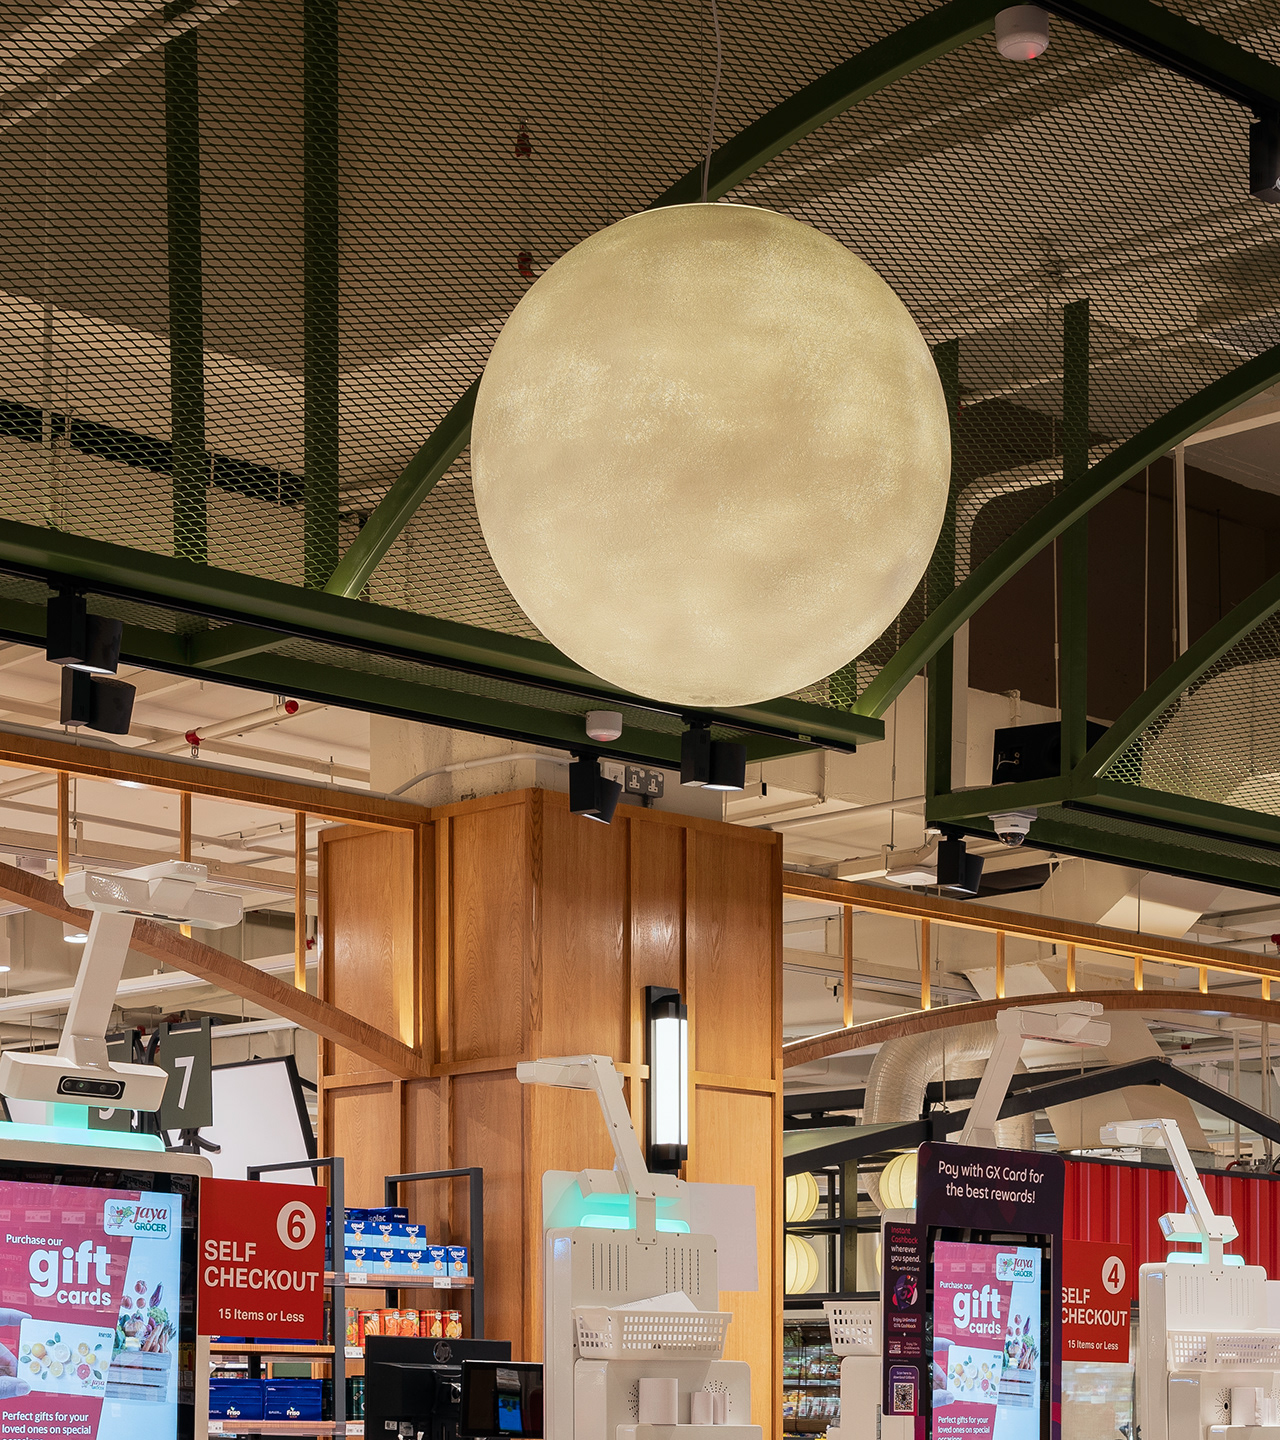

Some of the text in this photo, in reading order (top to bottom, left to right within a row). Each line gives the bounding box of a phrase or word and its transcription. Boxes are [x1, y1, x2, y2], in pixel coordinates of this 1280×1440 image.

[175, 1056, 194, 1109] 7
[939, 1161, 1044, 1183] Pay with GX Card for
[946, 1183, 1035, 1203] the best rewards!
[130, 1206, 167, 1223] Jaya
[134, 1222, 167, 1232] GROCER
[288, 1209, 305, 1243] 6
[6, 1234, 62, 1246] Purchase our
[891, 1235, 918, 1244] Cashback
[204, 1240, 256, 1262] SELF
[891, 1245, 916, 1253] wherever
[891, 1255, 921, 1263] you spend.
[29, 1240, 111, 1298] gift
[1108, 1263, 1119, 1288] 4
[204, 1267, 319, 1292] CHECKOUT
[940, 1281, 962, 1289] Purchase
[57, 1288, 111, 1306] cards
[1062, 1287, 1090, 1304] SELF
[219, 1308, 304, 1323] 15 Items or Less
[953, 1285, 1001, 1329] gift
[969, 1321, 1001, 1334] cards
[1068, 1340, 1076, 1348] 15
[1077, 1340, 1093, 1349] Items
[1104, 1341, 1118, 1350] Less
[2, 1411, 88, 1423] Perfect gifts for your
[2, 1425, 25, 1434] loved
[27, 1426, 48, 1434] ones
[63, 1426, 91, 1435] special
